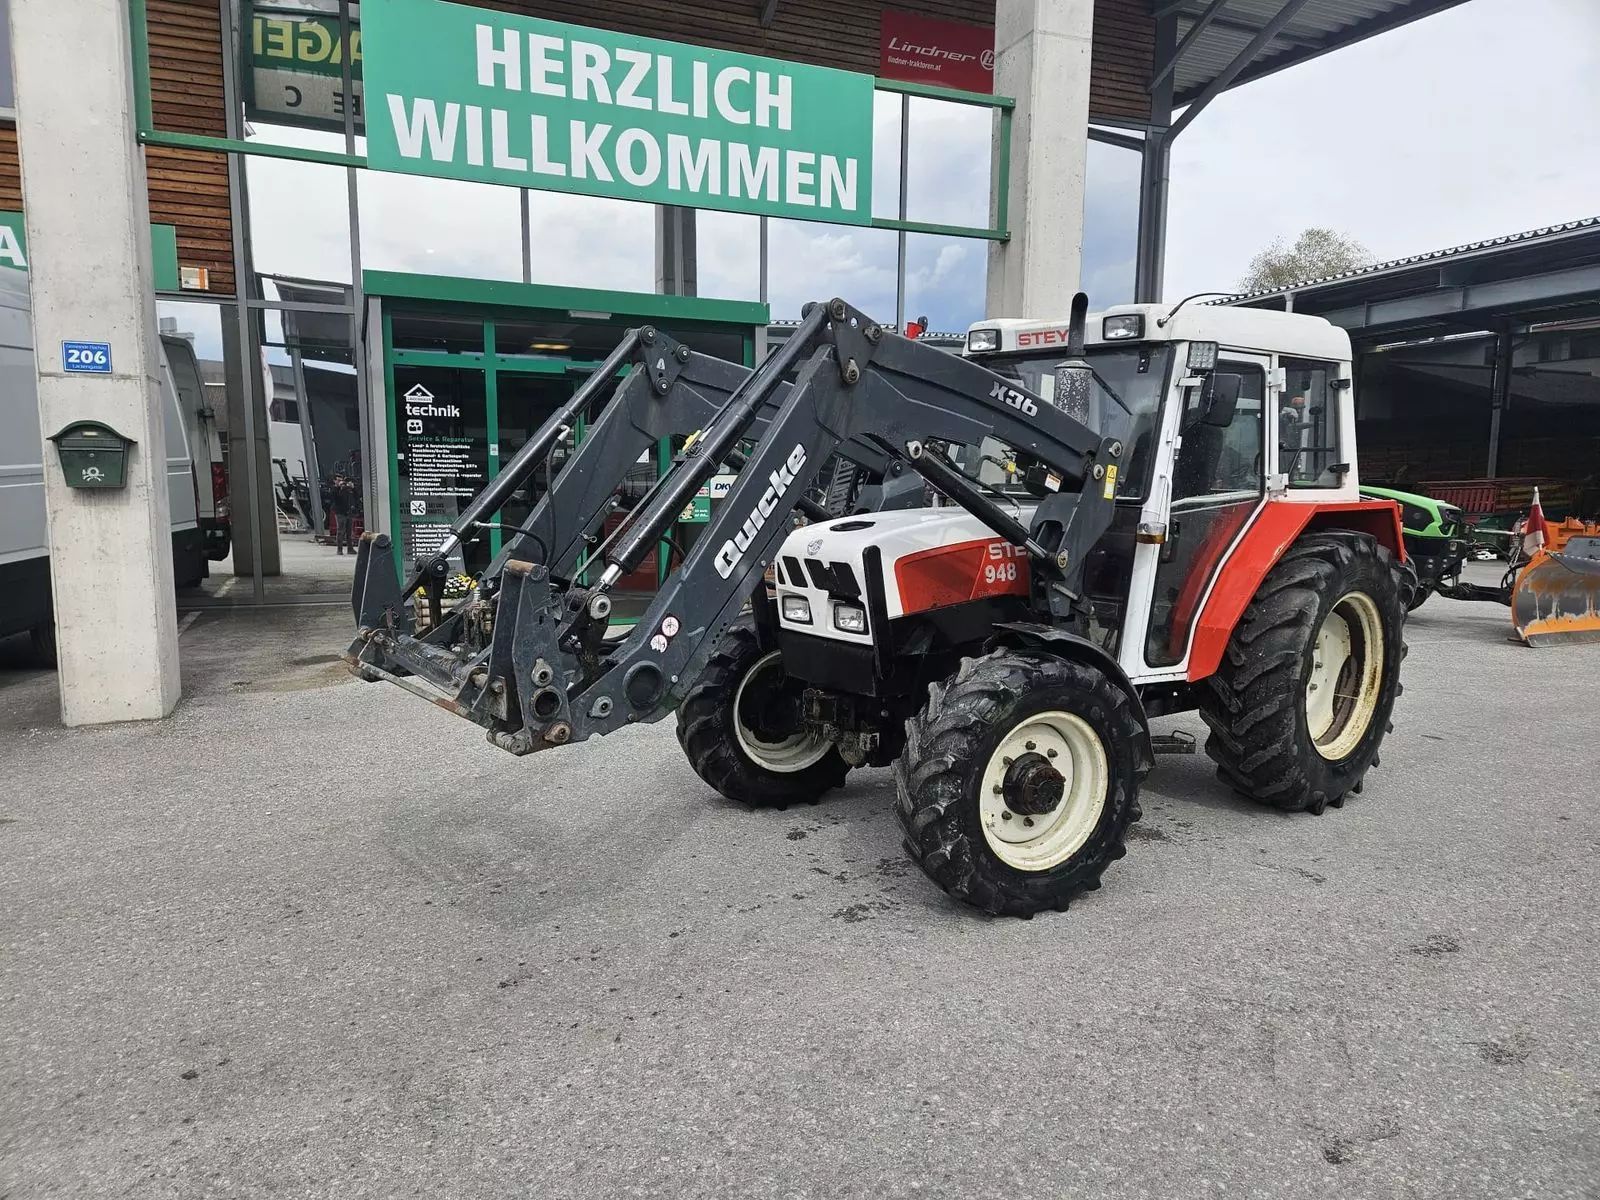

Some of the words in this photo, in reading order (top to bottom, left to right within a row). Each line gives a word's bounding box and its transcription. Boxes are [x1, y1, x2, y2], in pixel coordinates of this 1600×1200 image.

[888, 37, 976, 62] Lindner
[888, 55, 942, 72] lindner-traktoren.at
[475, 24, 792, 131] HERZLICH
[386, 93, 858, 212] WILLKOMMEN
[68, 349, 107, 365] 206
[405, 403, 460, 418] technik
[714, 443, 807, 580] Quicke
[984, 562, 1017, 584] 948
